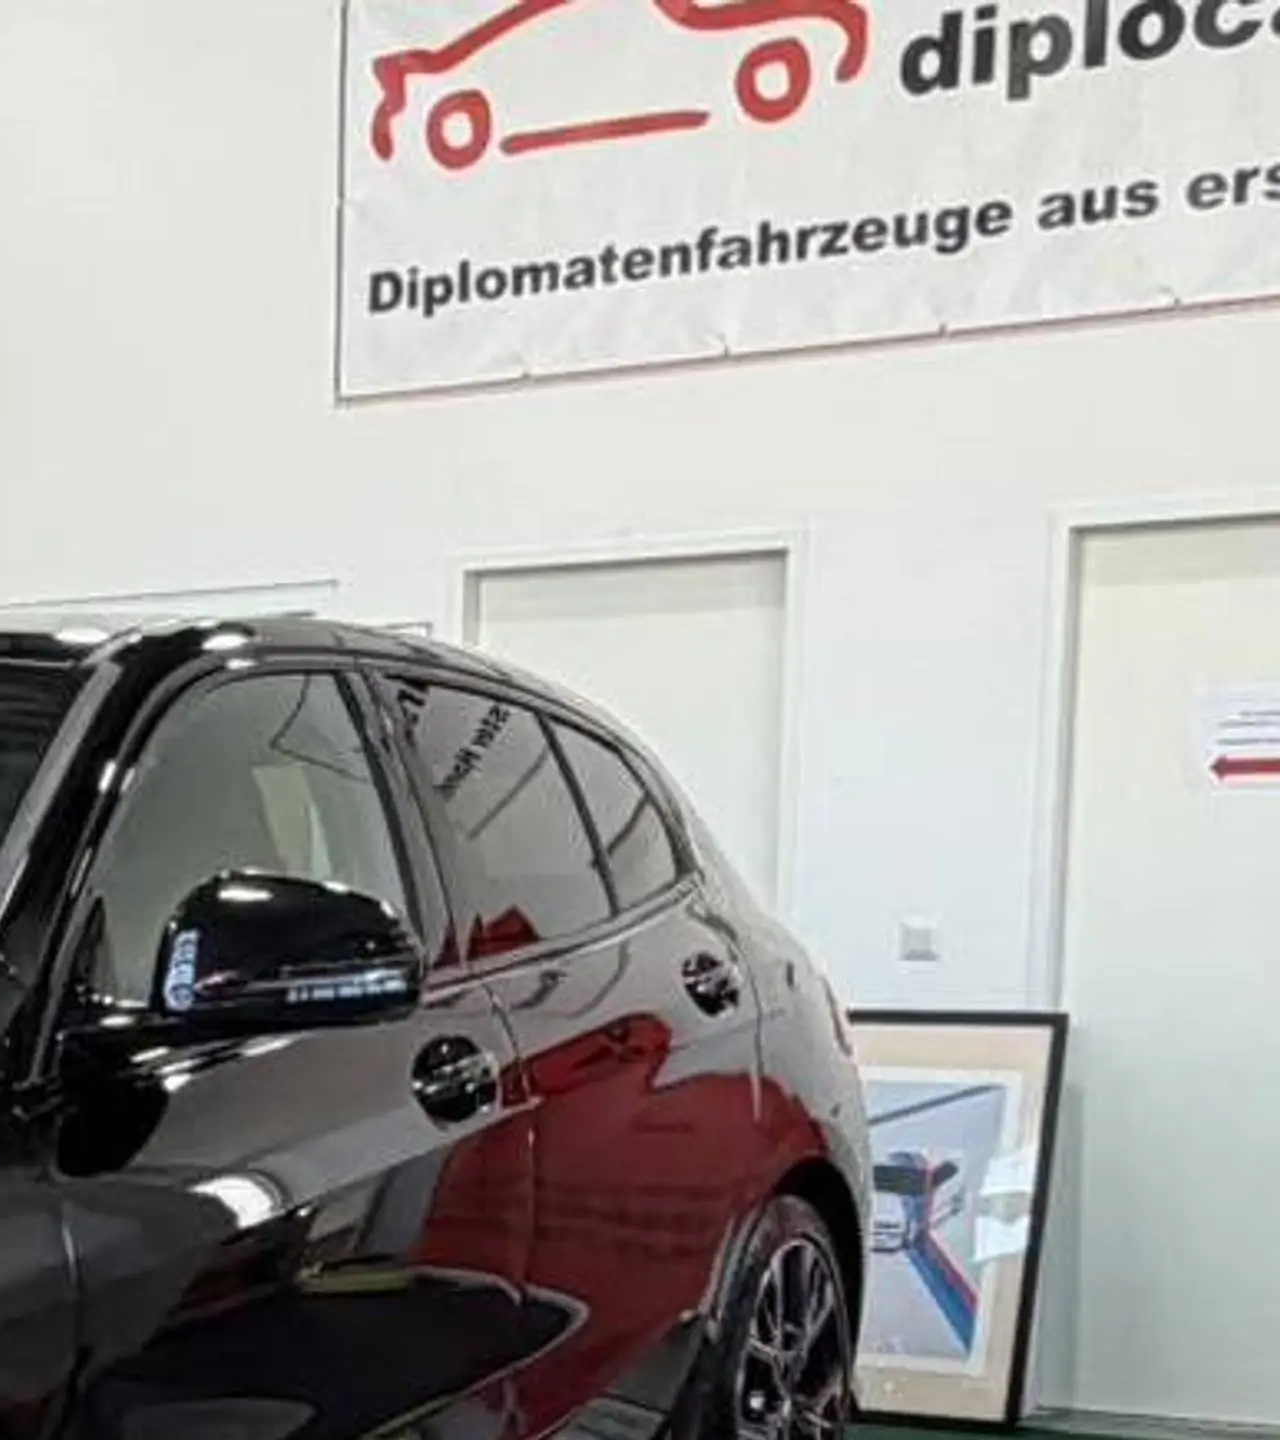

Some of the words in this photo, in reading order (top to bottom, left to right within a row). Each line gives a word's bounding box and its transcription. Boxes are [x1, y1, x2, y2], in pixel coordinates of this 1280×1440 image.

[900, 0, 1280, 101] diploc
[368, 199, 1013, 318] Diplomatenfahrzeuge
[1038, 178, 1160, 231] aus
